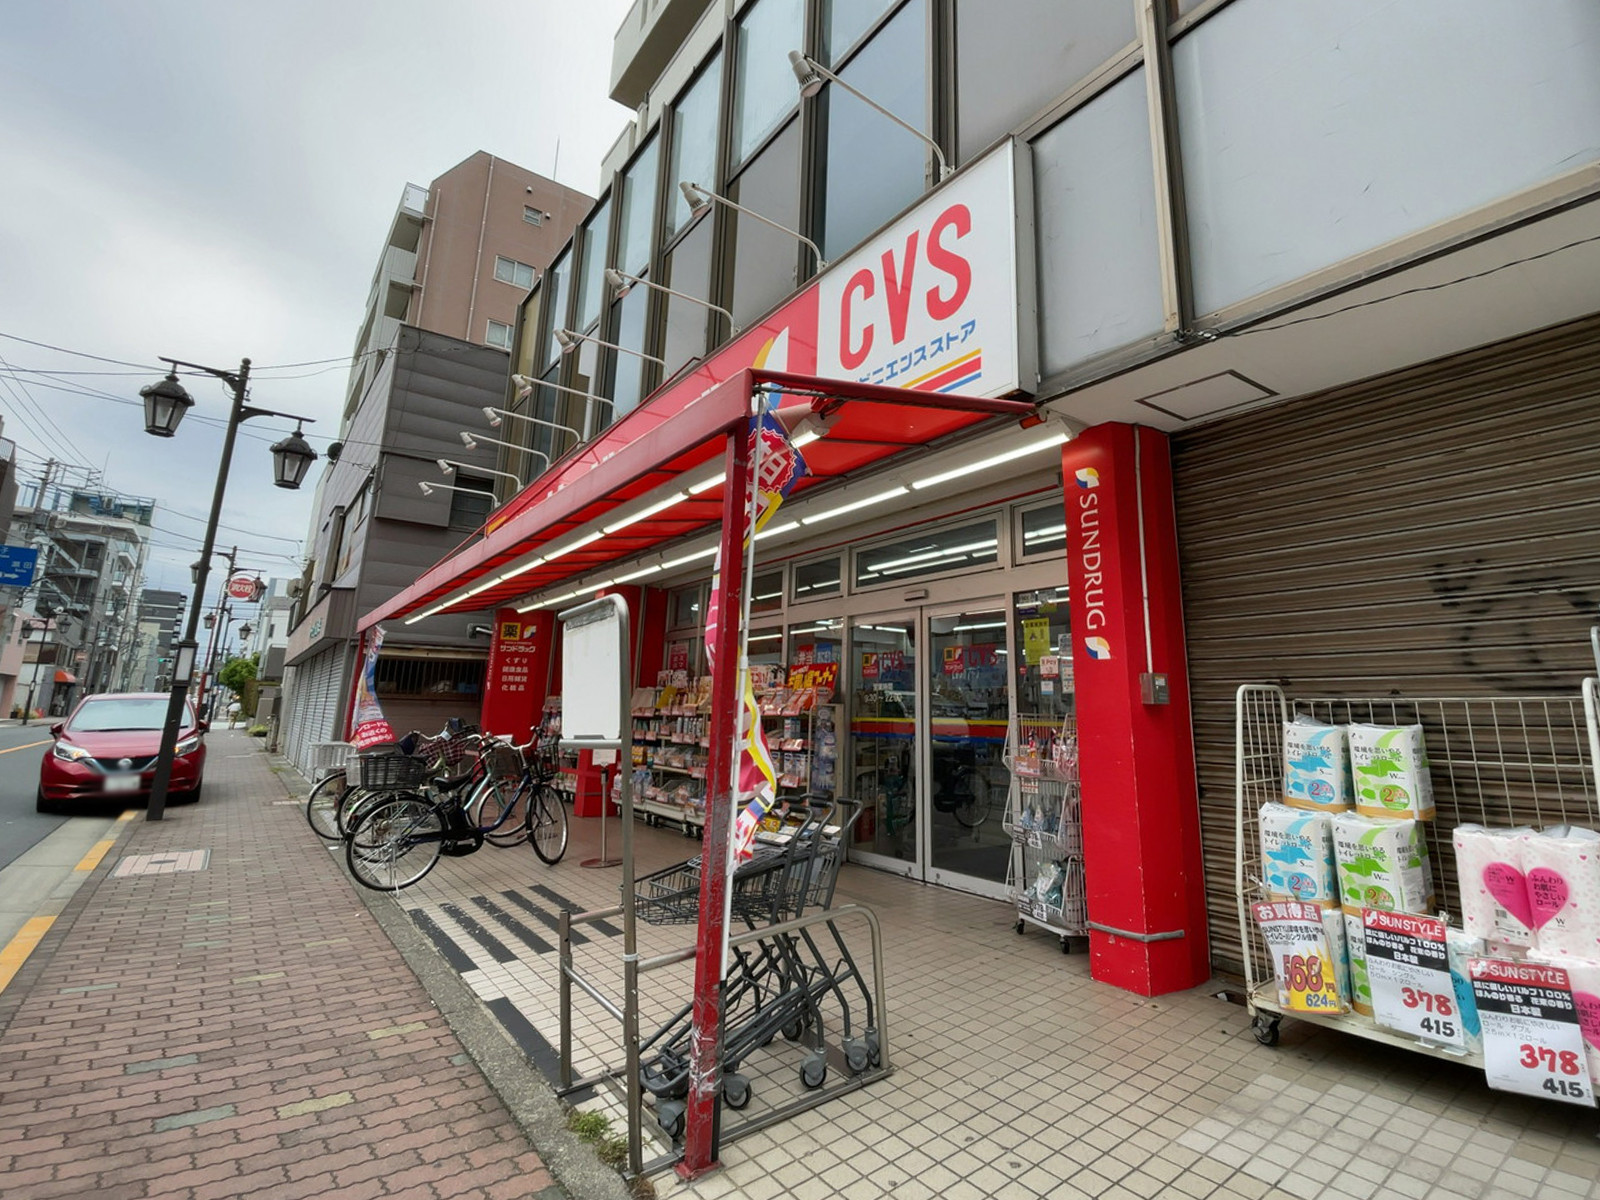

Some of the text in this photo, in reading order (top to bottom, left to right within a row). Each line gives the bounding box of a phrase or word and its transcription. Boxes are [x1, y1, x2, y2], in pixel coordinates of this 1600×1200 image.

[839, 203, 972, 371] CVS
[1079, 491, 1108, 631] SUNDRUG
[1257, 902, 1319, 920] お買得品
[1379, 915, 1443, 937] SUNSTYLE
[1490, 964, 1566, 985] SUNSTYLE
[1401, 986, 1453, 1016] 378
[1420, 1017, 1455, 1037] 415
[1520, 1043, 1580, 1075] 378
[1542, 1077, 1584, 1098] 415
